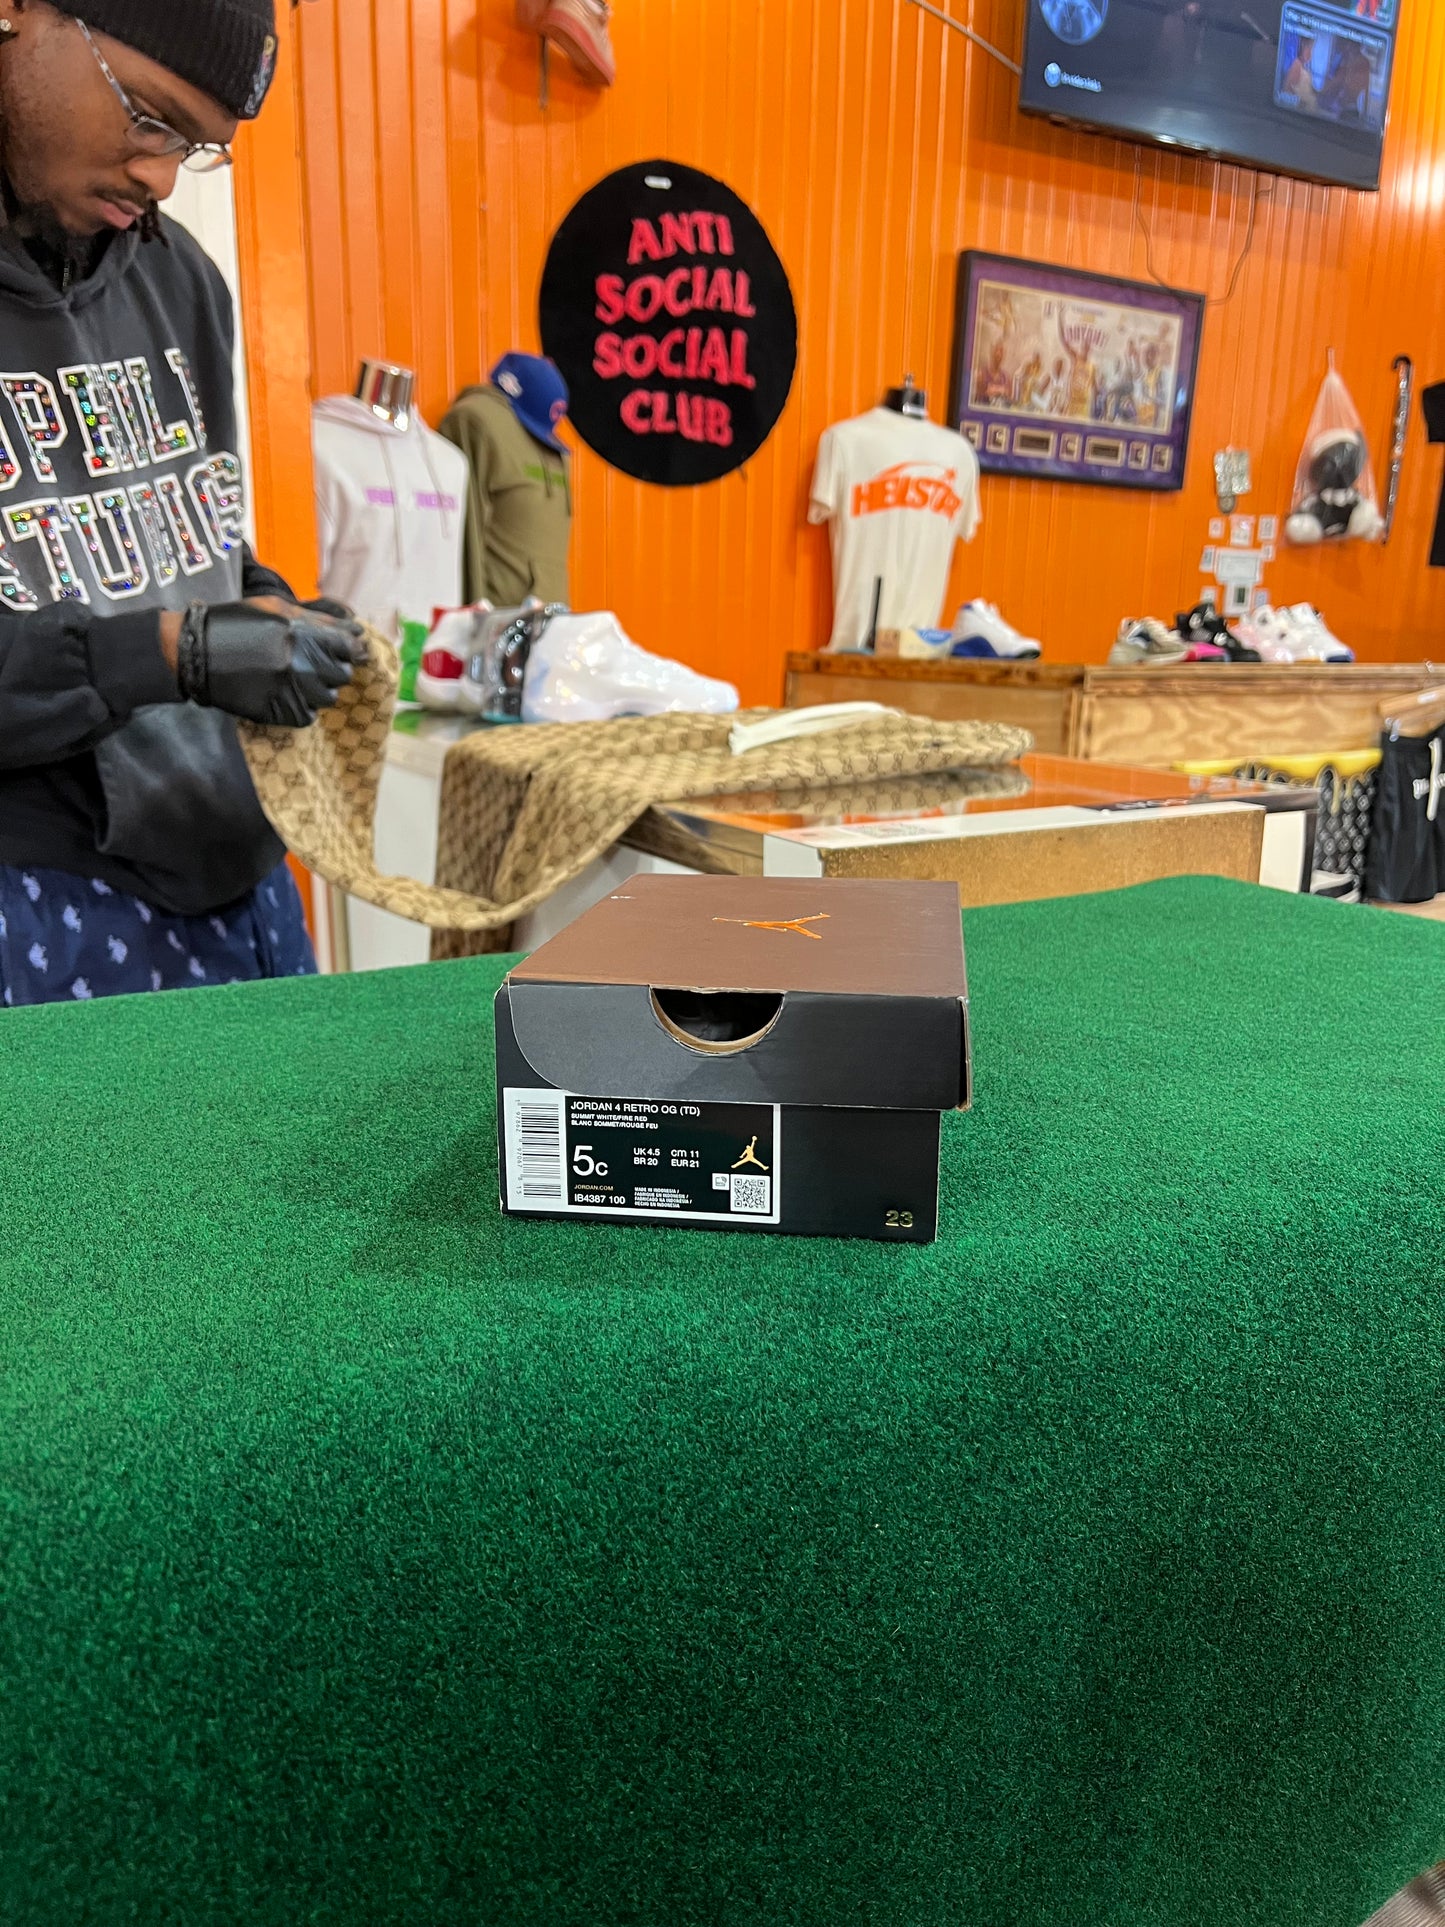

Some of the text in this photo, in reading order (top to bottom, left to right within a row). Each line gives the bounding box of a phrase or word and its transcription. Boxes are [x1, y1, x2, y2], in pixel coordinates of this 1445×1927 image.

[627, 210, 735, 265] ANTI
[595, 266, 756, 325] SOCIAL
[592, 326, 756, 390] SOCIAL
[620, 389, 734, 447] CLUB
[570, 1101, 700, 1117] JORDAN 4 RETRO OG (TD)
[633, 1147, 660, 1156] UK 4.5
[689, 1150, 699, 1158] 11
[633, 1157, 659, 1166] BR 20
[670, 1159, 700, 1168] EUR 21
[574, 1193, 626, 1204] IB4387 100
[885, 1209, 913, 1228] 23
